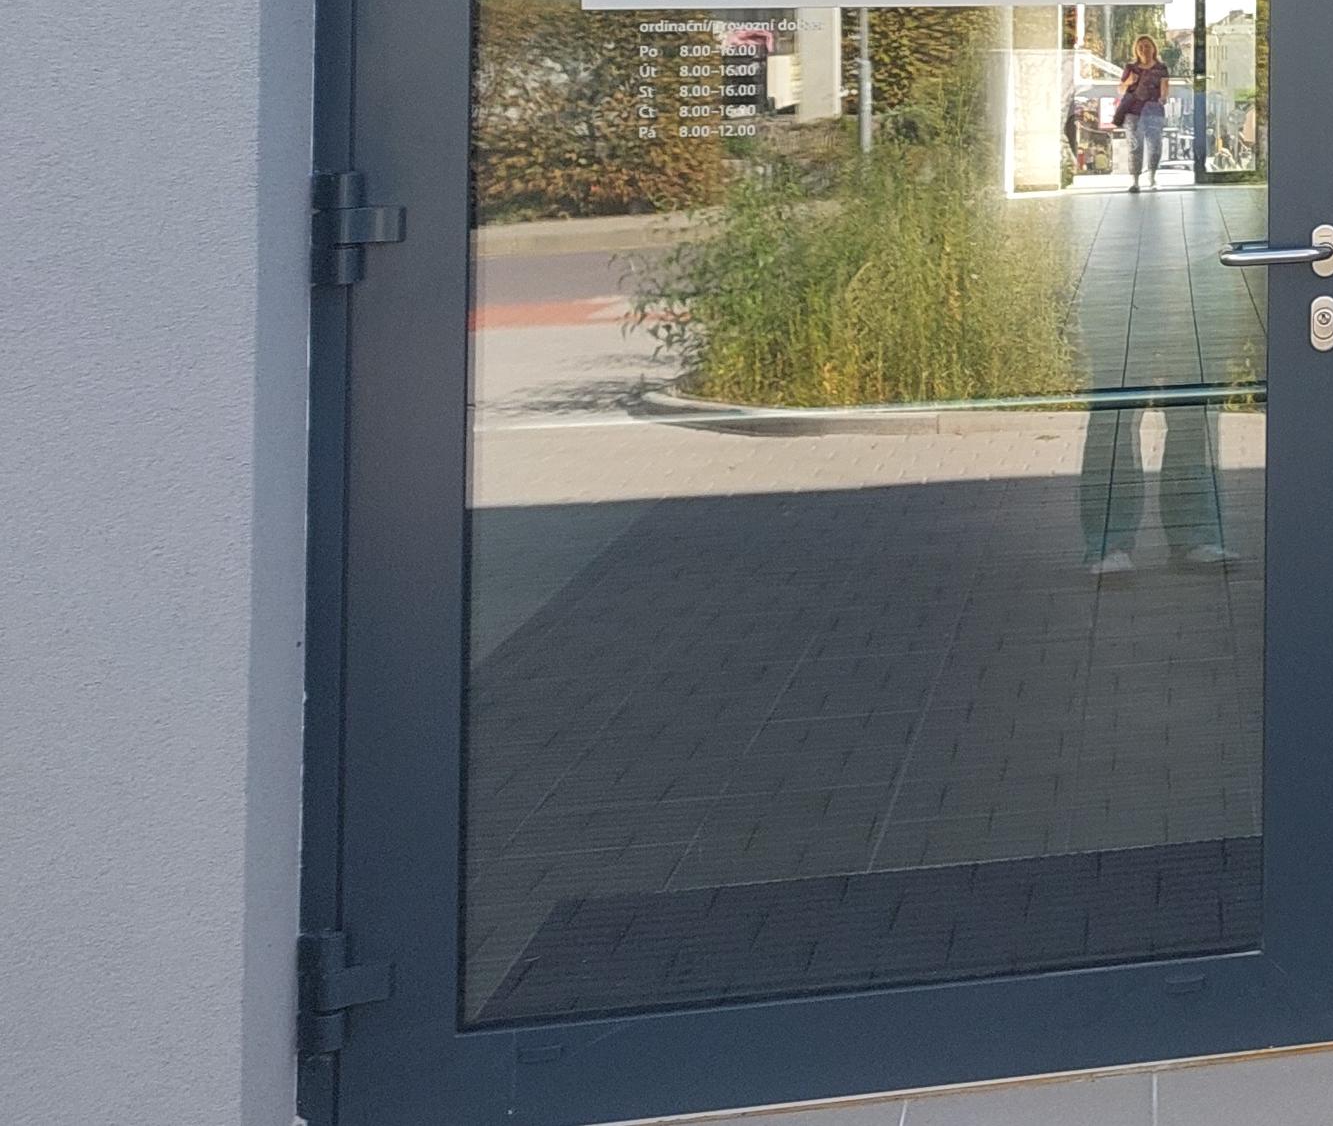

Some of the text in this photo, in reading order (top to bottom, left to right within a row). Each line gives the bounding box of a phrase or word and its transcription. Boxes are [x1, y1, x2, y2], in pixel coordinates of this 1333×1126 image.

[679, 45, 757, 57] 8.00–16.00
[679, 64, 757, 77] 8.00–16.00
[679, 84, 757, 97] 8.00–16.00
[679, 124, 757, 138] 8.00–12.00
